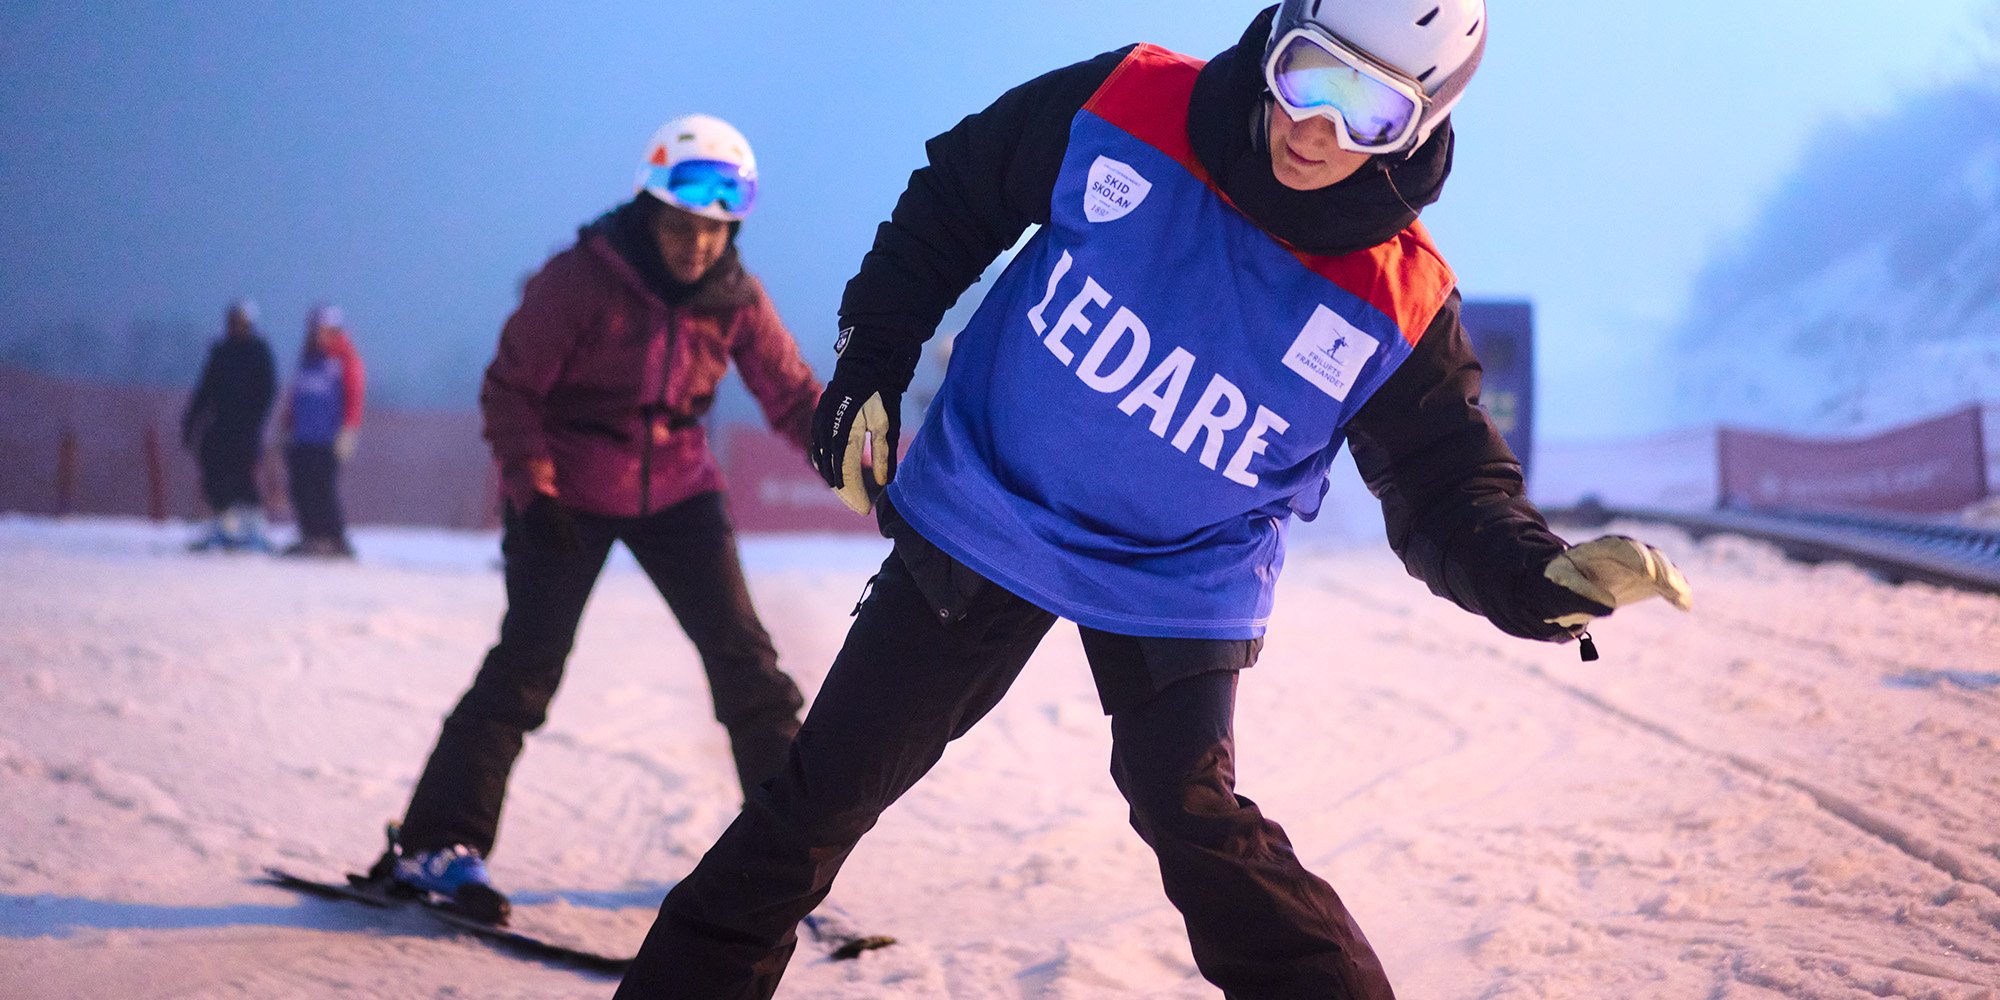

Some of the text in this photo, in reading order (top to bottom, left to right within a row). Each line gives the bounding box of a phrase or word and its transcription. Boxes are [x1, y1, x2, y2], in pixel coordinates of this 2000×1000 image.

[1092, 181, 1131, 208] SKOLAN
[1104, 174, 1130, 194] SKID
[1027, 249, 1290, 488] LEDARE
[1308, 351, 1342, 377] FRILUFTS
[832, 395, 852, 437] HESTRA
